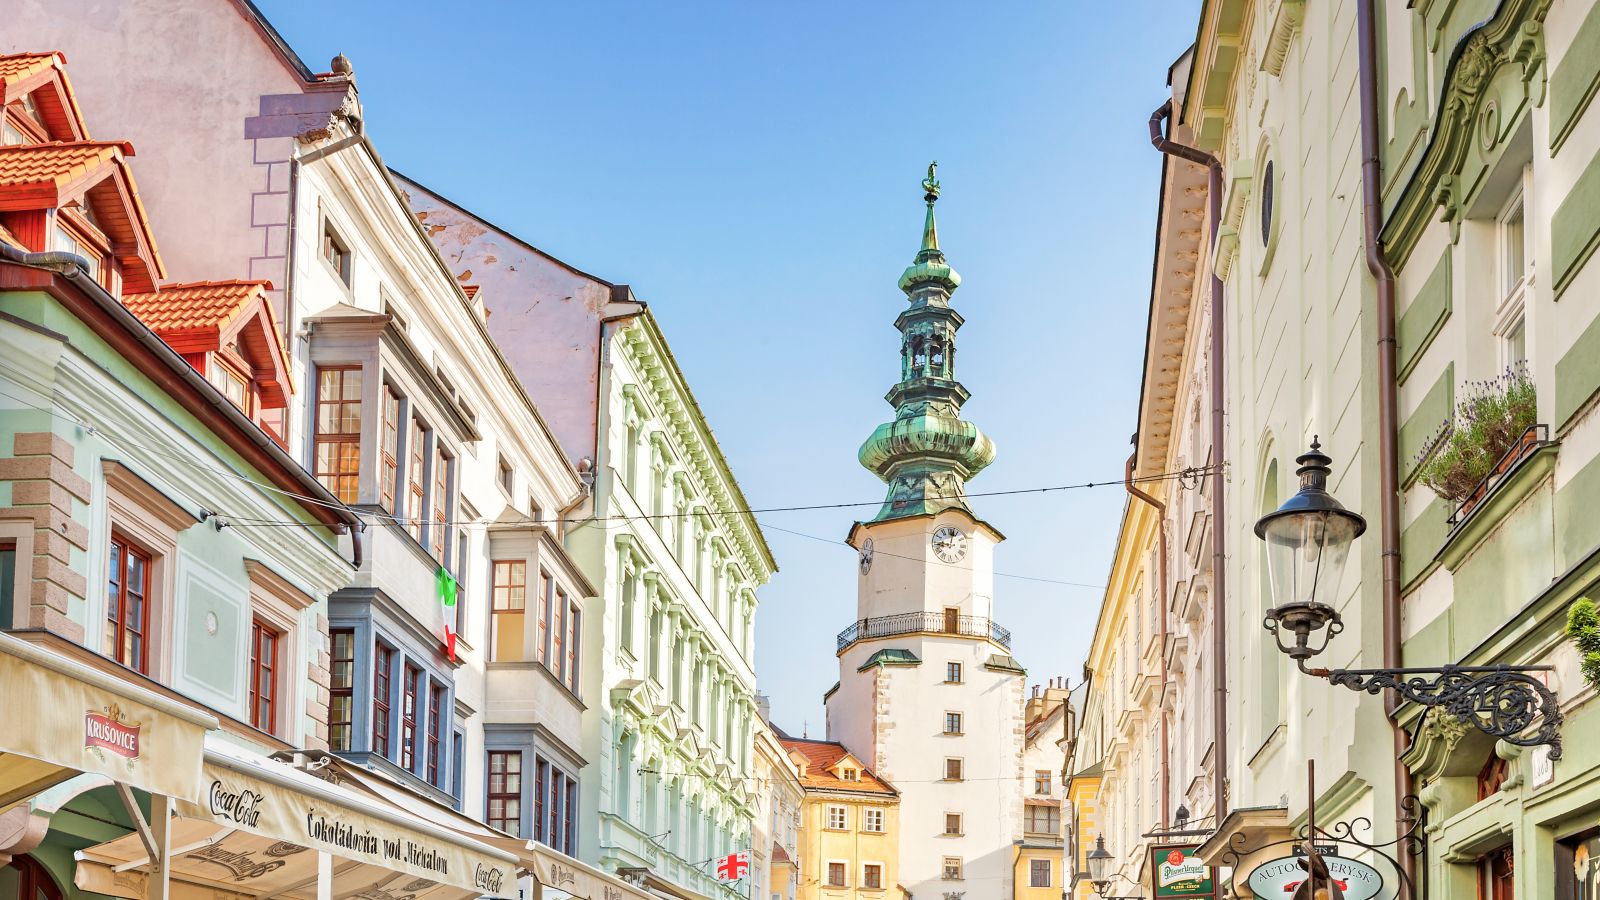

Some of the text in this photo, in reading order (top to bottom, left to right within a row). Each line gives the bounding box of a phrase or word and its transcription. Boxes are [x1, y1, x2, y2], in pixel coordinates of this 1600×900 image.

[87, 717, 135, 751] KRUŠOVICE
[210, 780, 265, 828] Coca-Cola
[307, 807, 448, 875] Čokoládovňa pod Michalom
[1258, 862, 1374, 883] AUTOERY.SK
